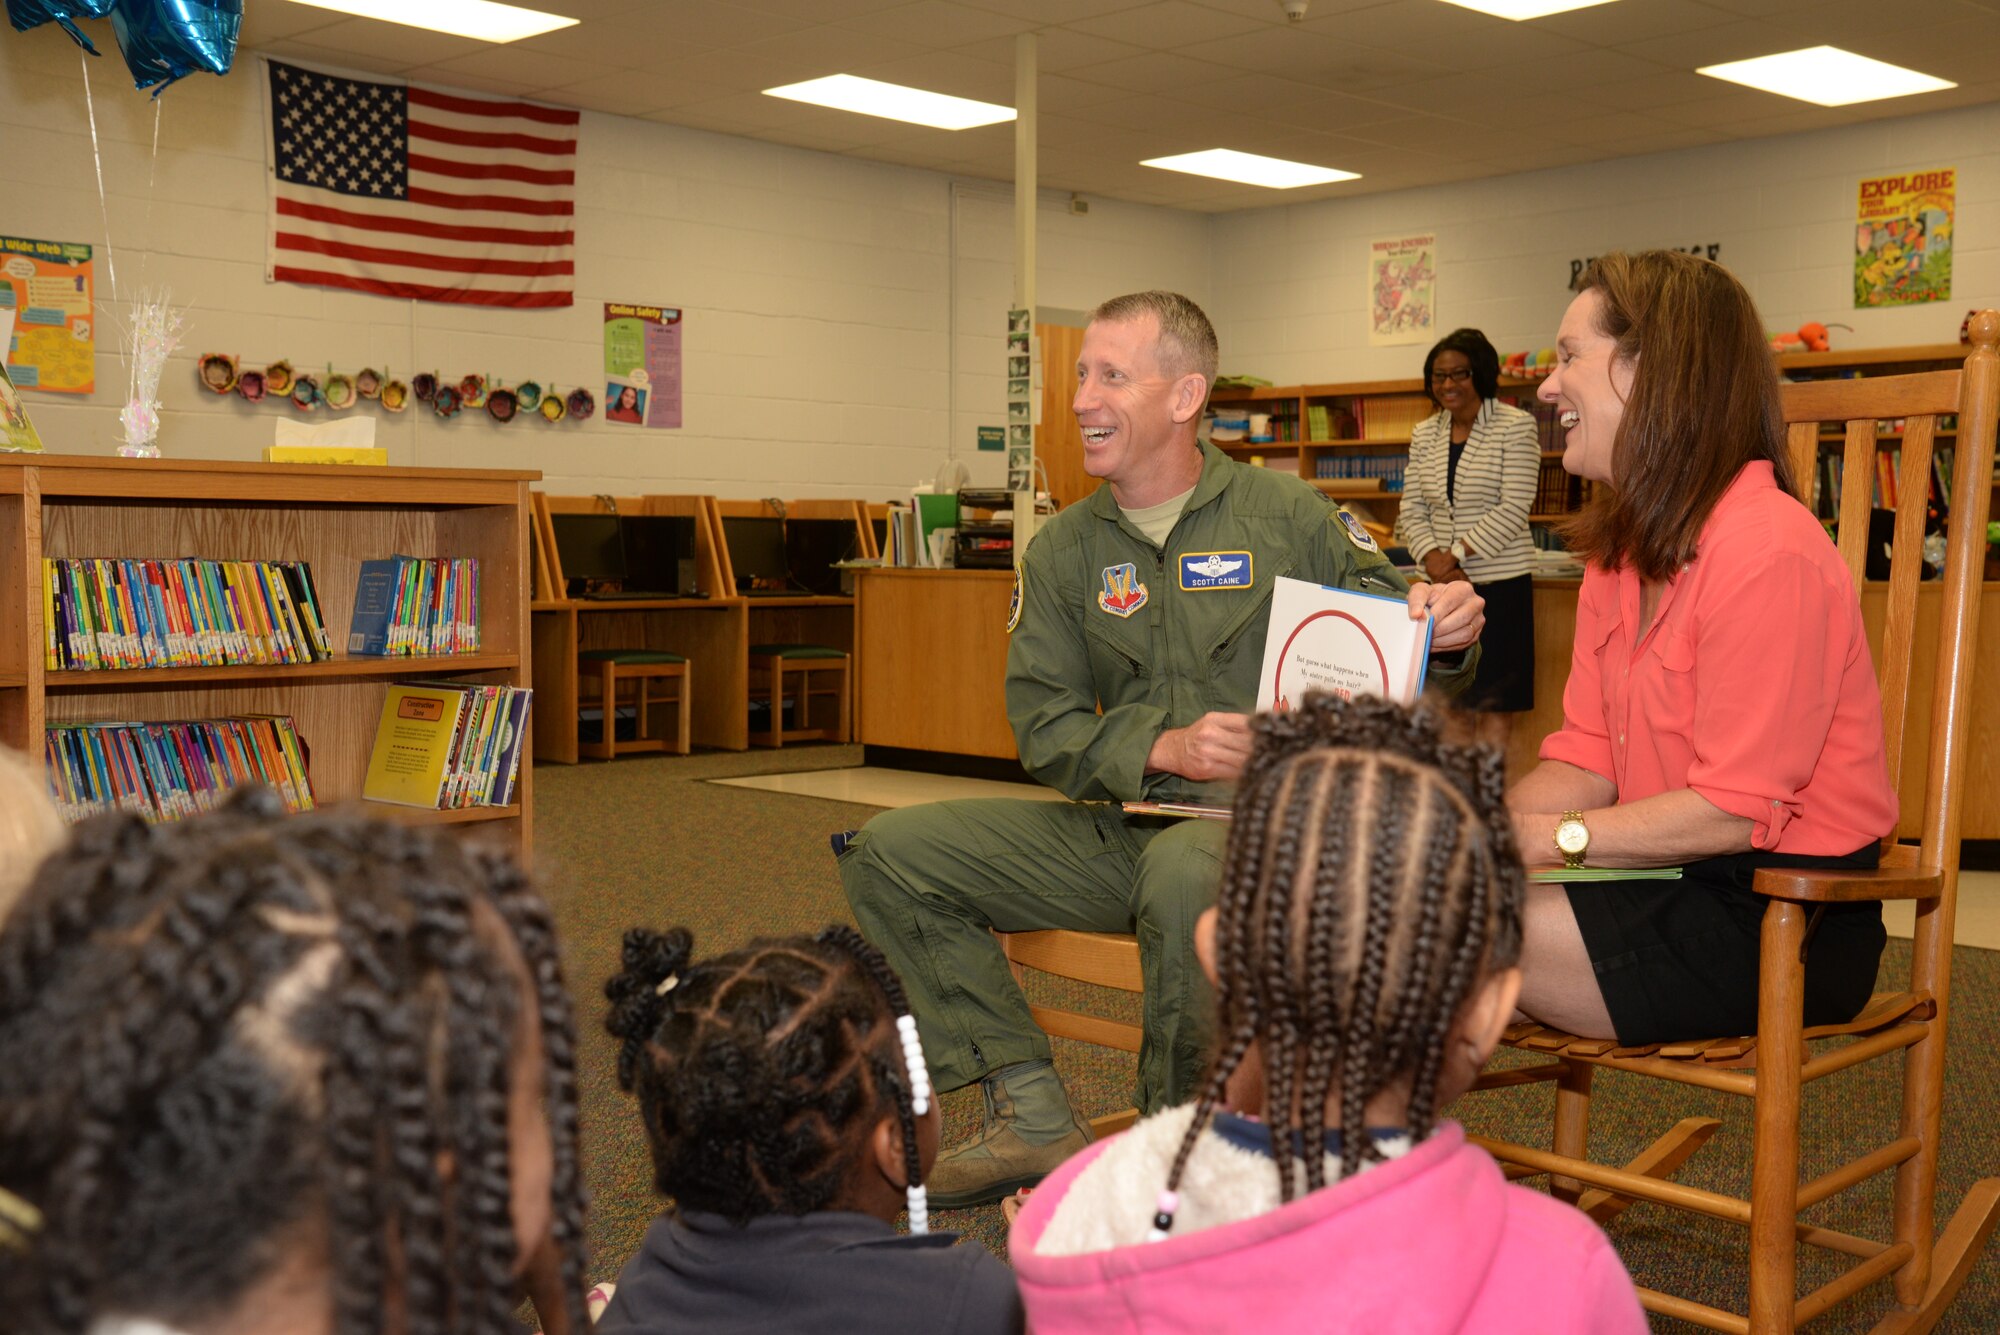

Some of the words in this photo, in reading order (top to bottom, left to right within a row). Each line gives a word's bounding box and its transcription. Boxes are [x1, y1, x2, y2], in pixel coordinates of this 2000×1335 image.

[1861, 171, 1953, 198] EXPLORE
[5, 239, 34, 253] Wide
[36, 243, 61, 256] Web
[609, 304, 635, 315] Online
[636, 307, 661, 319] Safety
[1192, 578, 1215, 586] SCOTT
[1110, 606, 1128, 615] COMBAT
[1296, 654, 1305, 663] But
[1306, 658, 1319, 666] guess
[1320, 661, 1332, 670] what
[1333, 664, 1354, 675] happens
[1355, 670, 1369, 678] when
[407, 700, 435, 709] Construction
[413, 709, 424, 717] Zone
